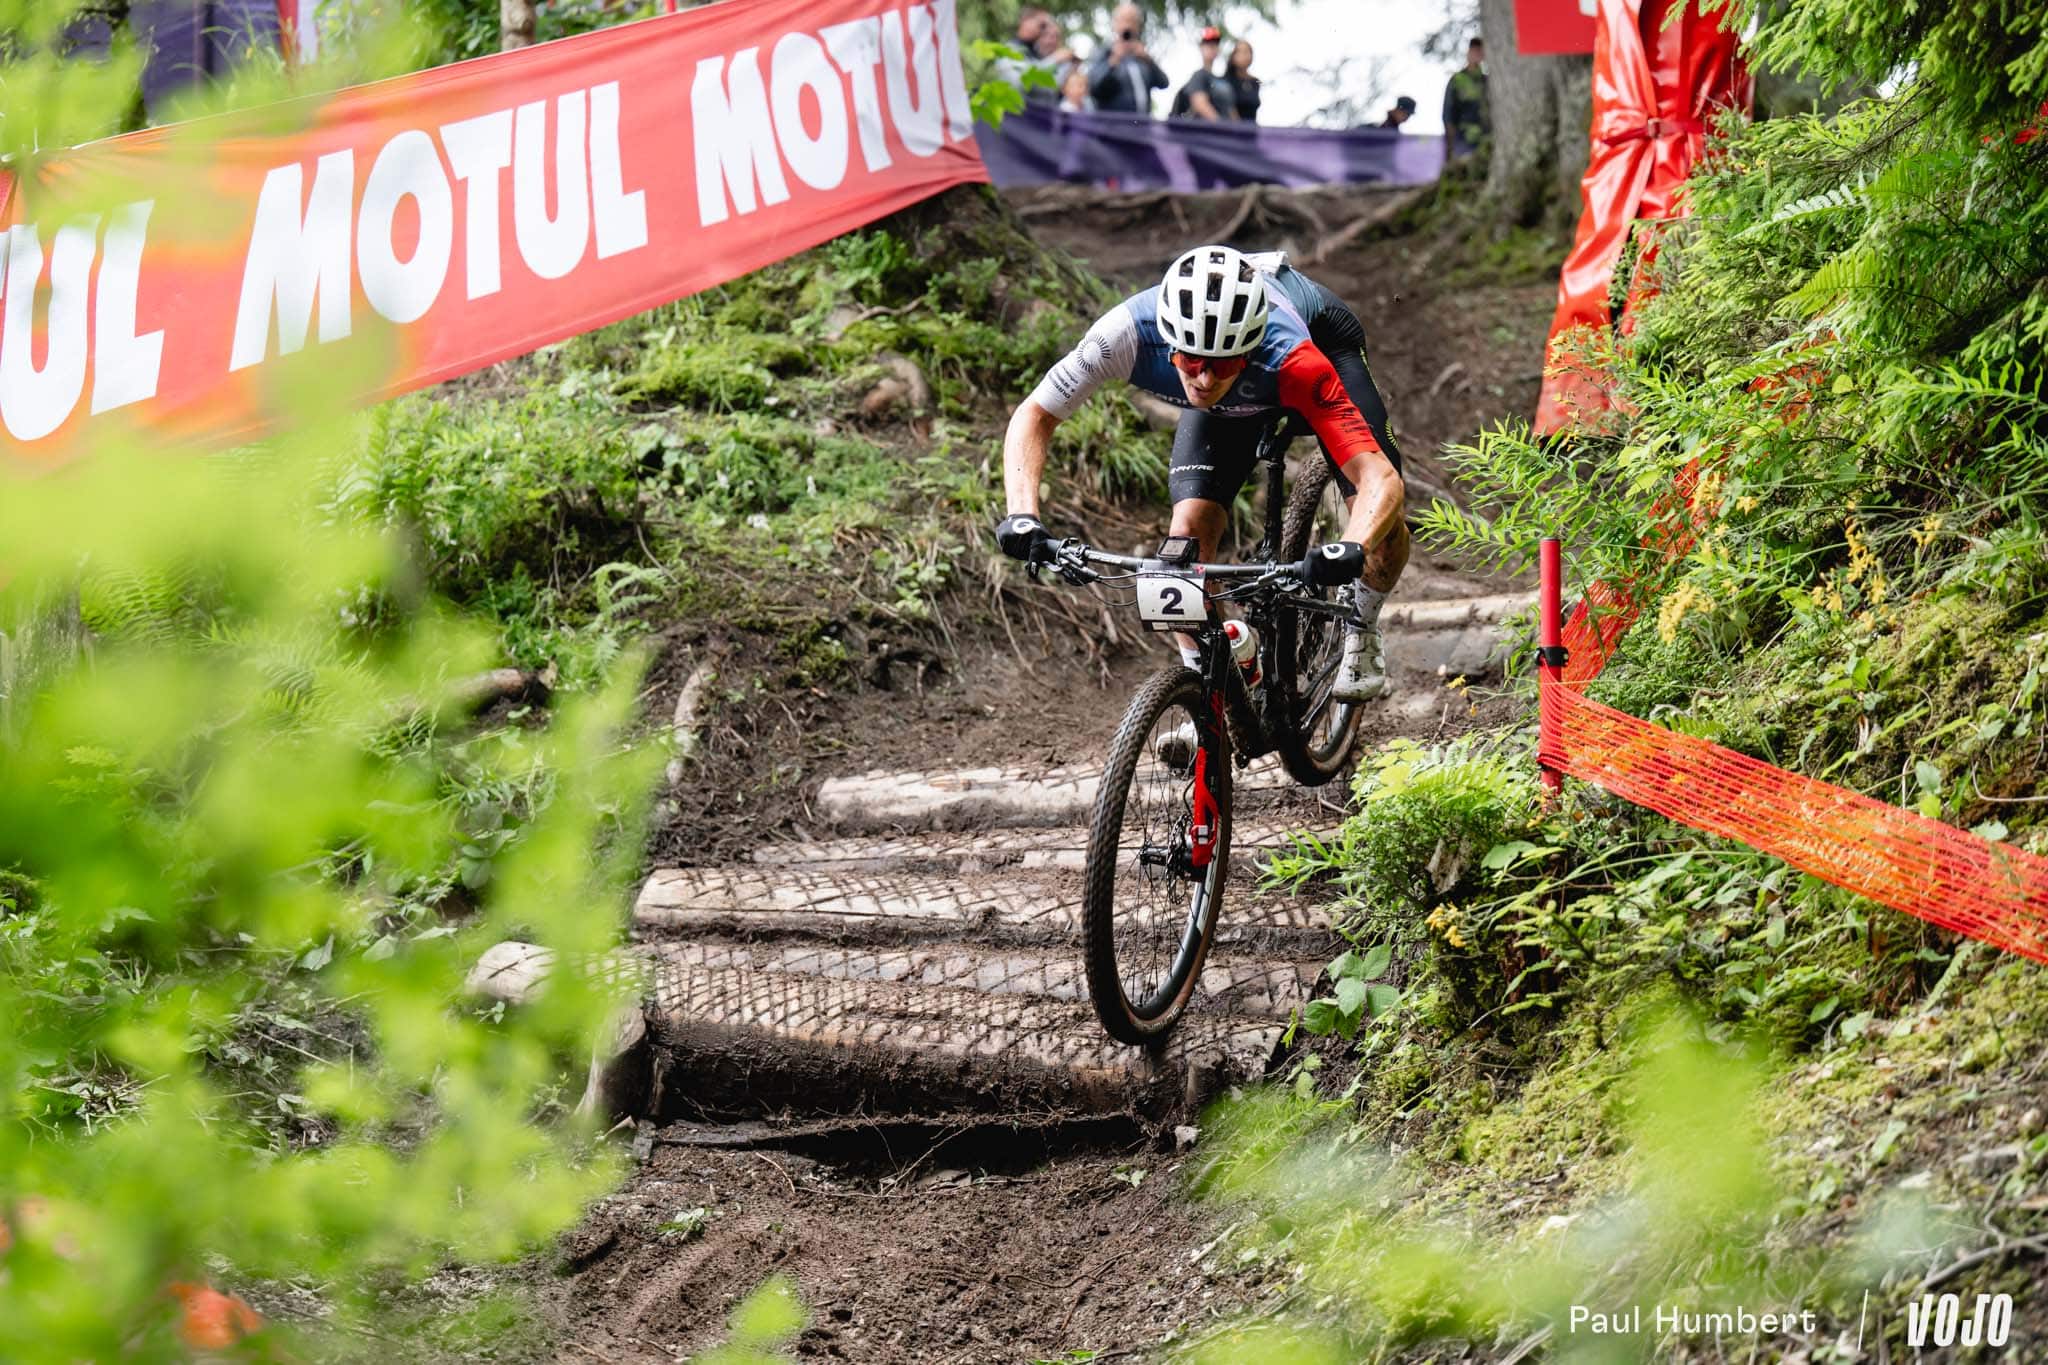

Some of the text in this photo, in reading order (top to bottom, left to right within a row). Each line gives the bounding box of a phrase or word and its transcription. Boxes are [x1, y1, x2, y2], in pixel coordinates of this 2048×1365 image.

[0, 200, 164, 440] UL
[229, 81, 648, 371] MOTUL
[1160, 587, 1185, 615] 2
